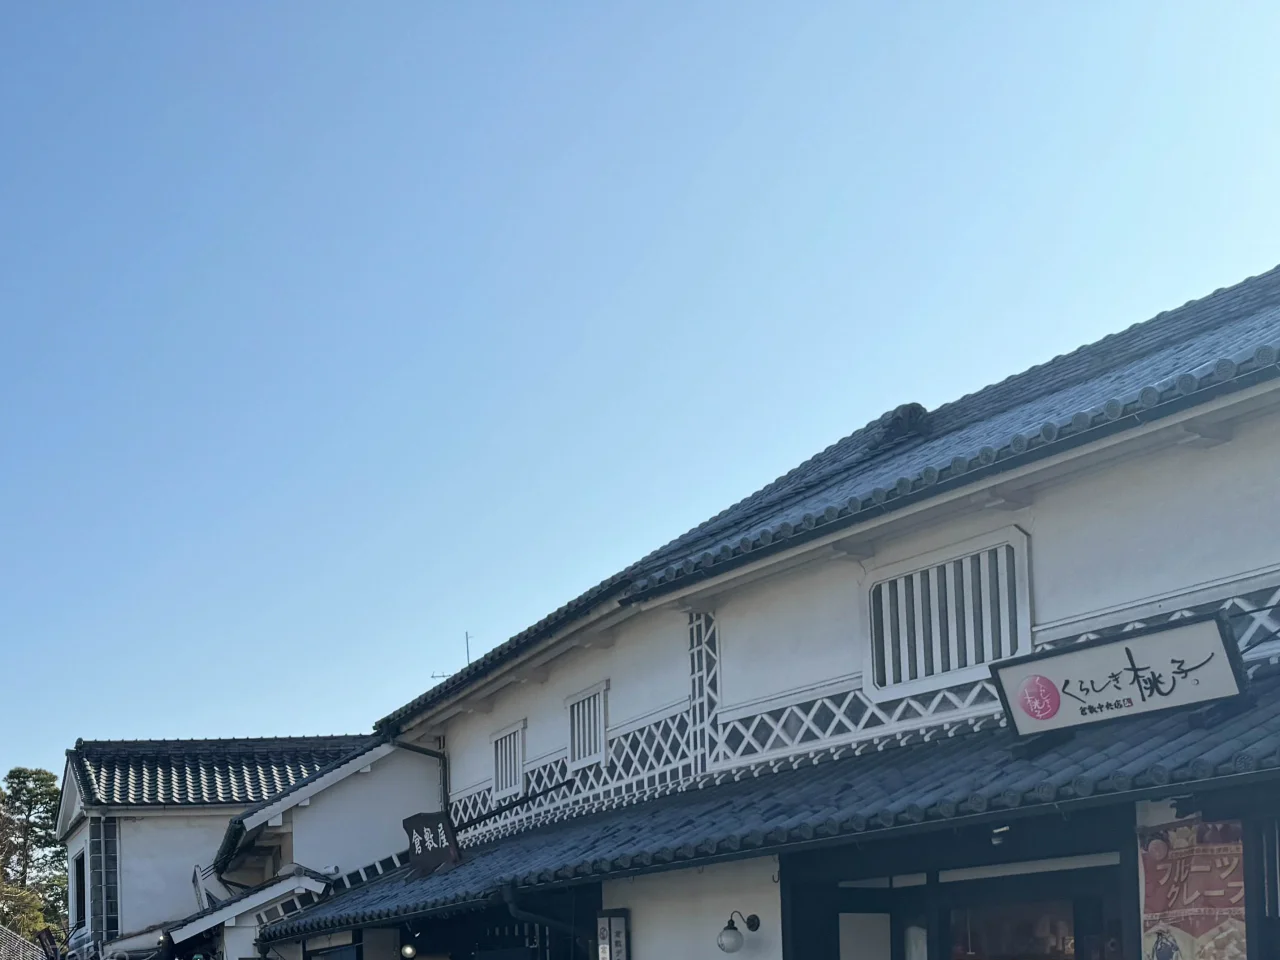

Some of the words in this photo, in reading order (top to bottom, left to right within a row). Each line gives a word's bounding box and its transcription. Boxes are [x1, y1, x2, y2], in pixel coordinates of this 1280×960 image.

[411, 822, 450, 855] 倉敷屋
[1156, 856, 1240, 886] フルーツ
